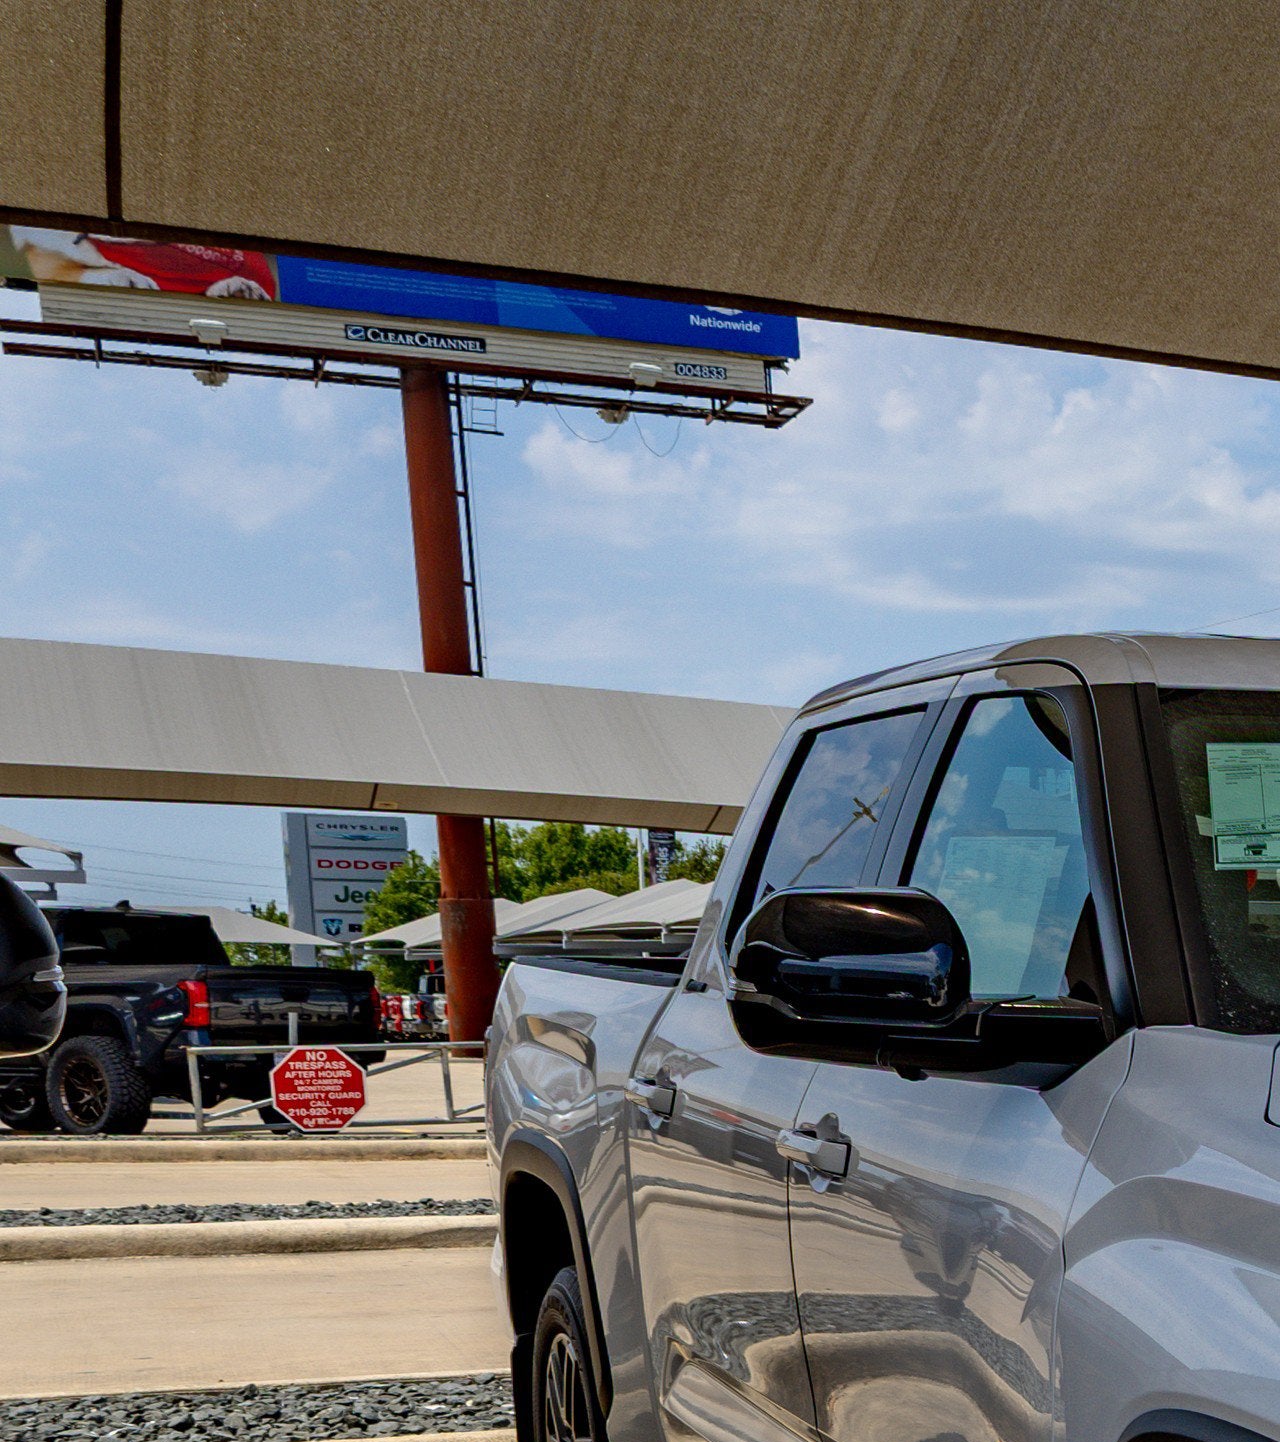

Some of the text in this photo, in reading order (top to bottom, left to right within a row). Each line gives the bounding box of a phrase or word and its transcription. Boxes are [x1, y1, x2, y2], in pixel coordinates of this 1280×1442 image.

[689, 314, 761, 333] Nationwide
[676, 364, 726, 380] 004833
[316, 823, 400, 832] CHRYSLER
[305, 1051, 327, 1061] NO
[288, 1061, 347, 1070] TRESPASS
[284, 1070, 352, 1079] AFTER HOURS
[278, 1091, 362, 1101] SECURITY GUARD
